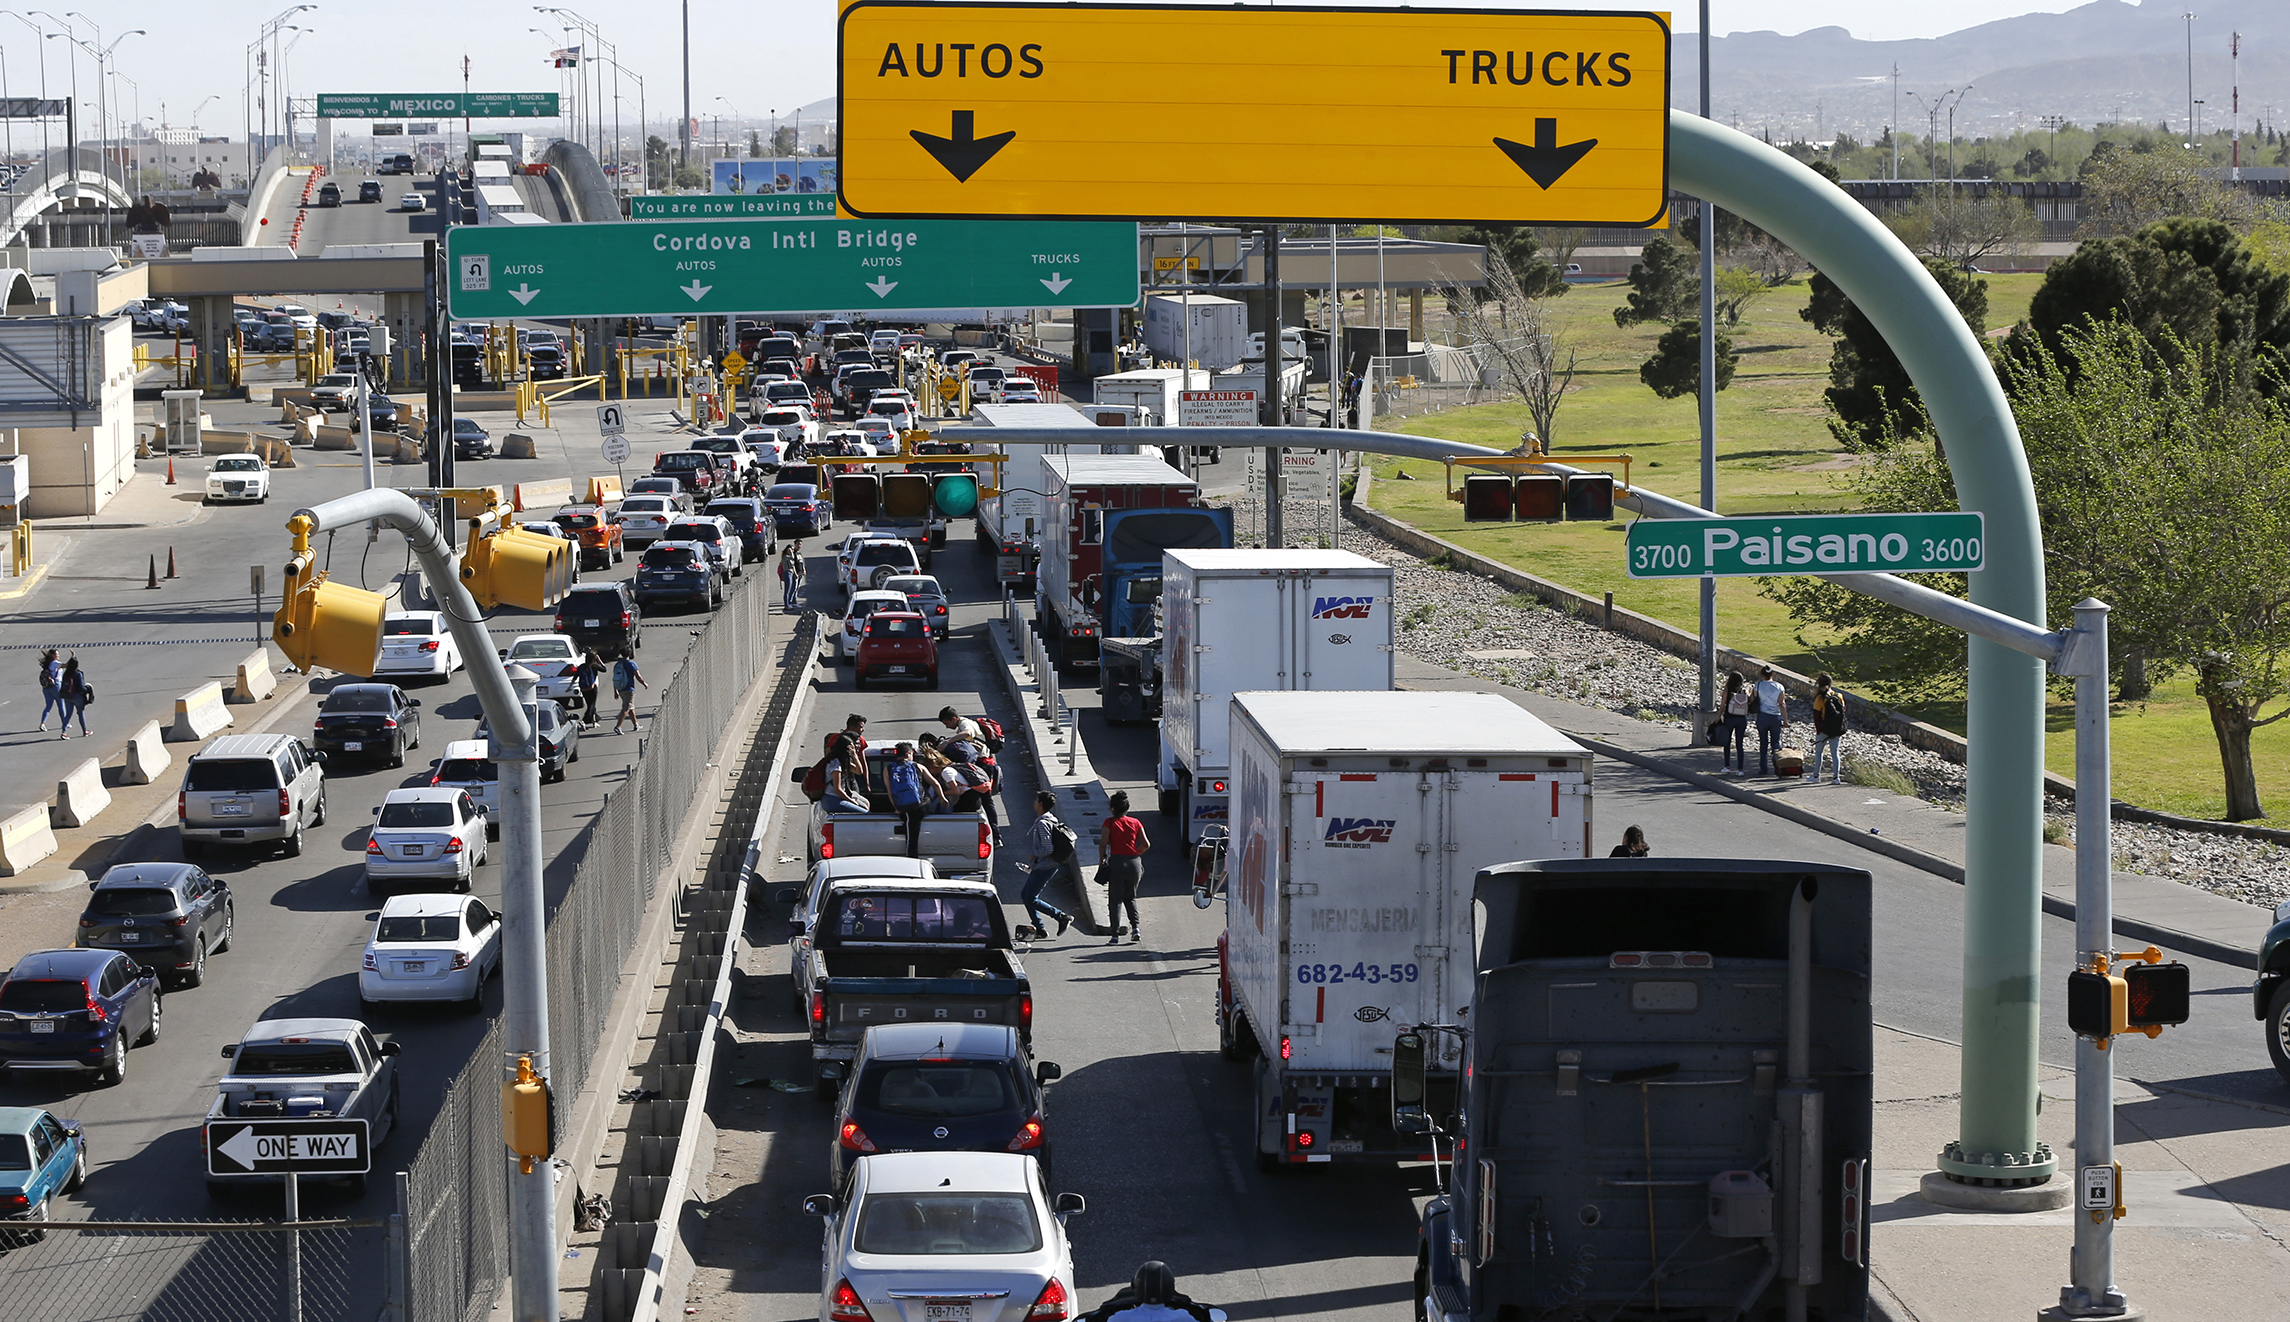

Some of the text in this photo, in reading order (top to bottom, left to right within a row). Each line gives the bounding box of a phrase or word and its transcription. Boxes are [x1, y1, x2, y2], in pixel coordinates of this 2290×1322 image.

[877, 42, 1044, 79] AUTOS
[1441, 49, 1632, 87] TRUCKS
[390, 99, 456, 111] MEXICO
[635, 199, 835, 214] You are now leaving the
[653, 229, 918, 252] Cordova Intl Bridge
[861, 256, 903, 267] AUTOS
[1031, 253, 1080, 264] TRUCKS
[503, 264, 544, 275] AUTOS
[675, 260, 717, 271] AUTOS
[1190, 392, 1247, 400] WARNING
[699, 409, 705, 417] 5
[1284, 456, 1316, 466] RNING
[1634, 525, 1981, 570] 3700 Paisano 3600
[923, 845, 975, 853] TUNDRA
[1311, 907, 1420, 934] MENSAJERIA
[1297, 961, 1419, 984] 682-43-59
[857, 1008, 987, 1019] FORD
[256, 1136, 350, 1158] ONE WAY
[926, 1306, 970, 1318] EKB-71-74
